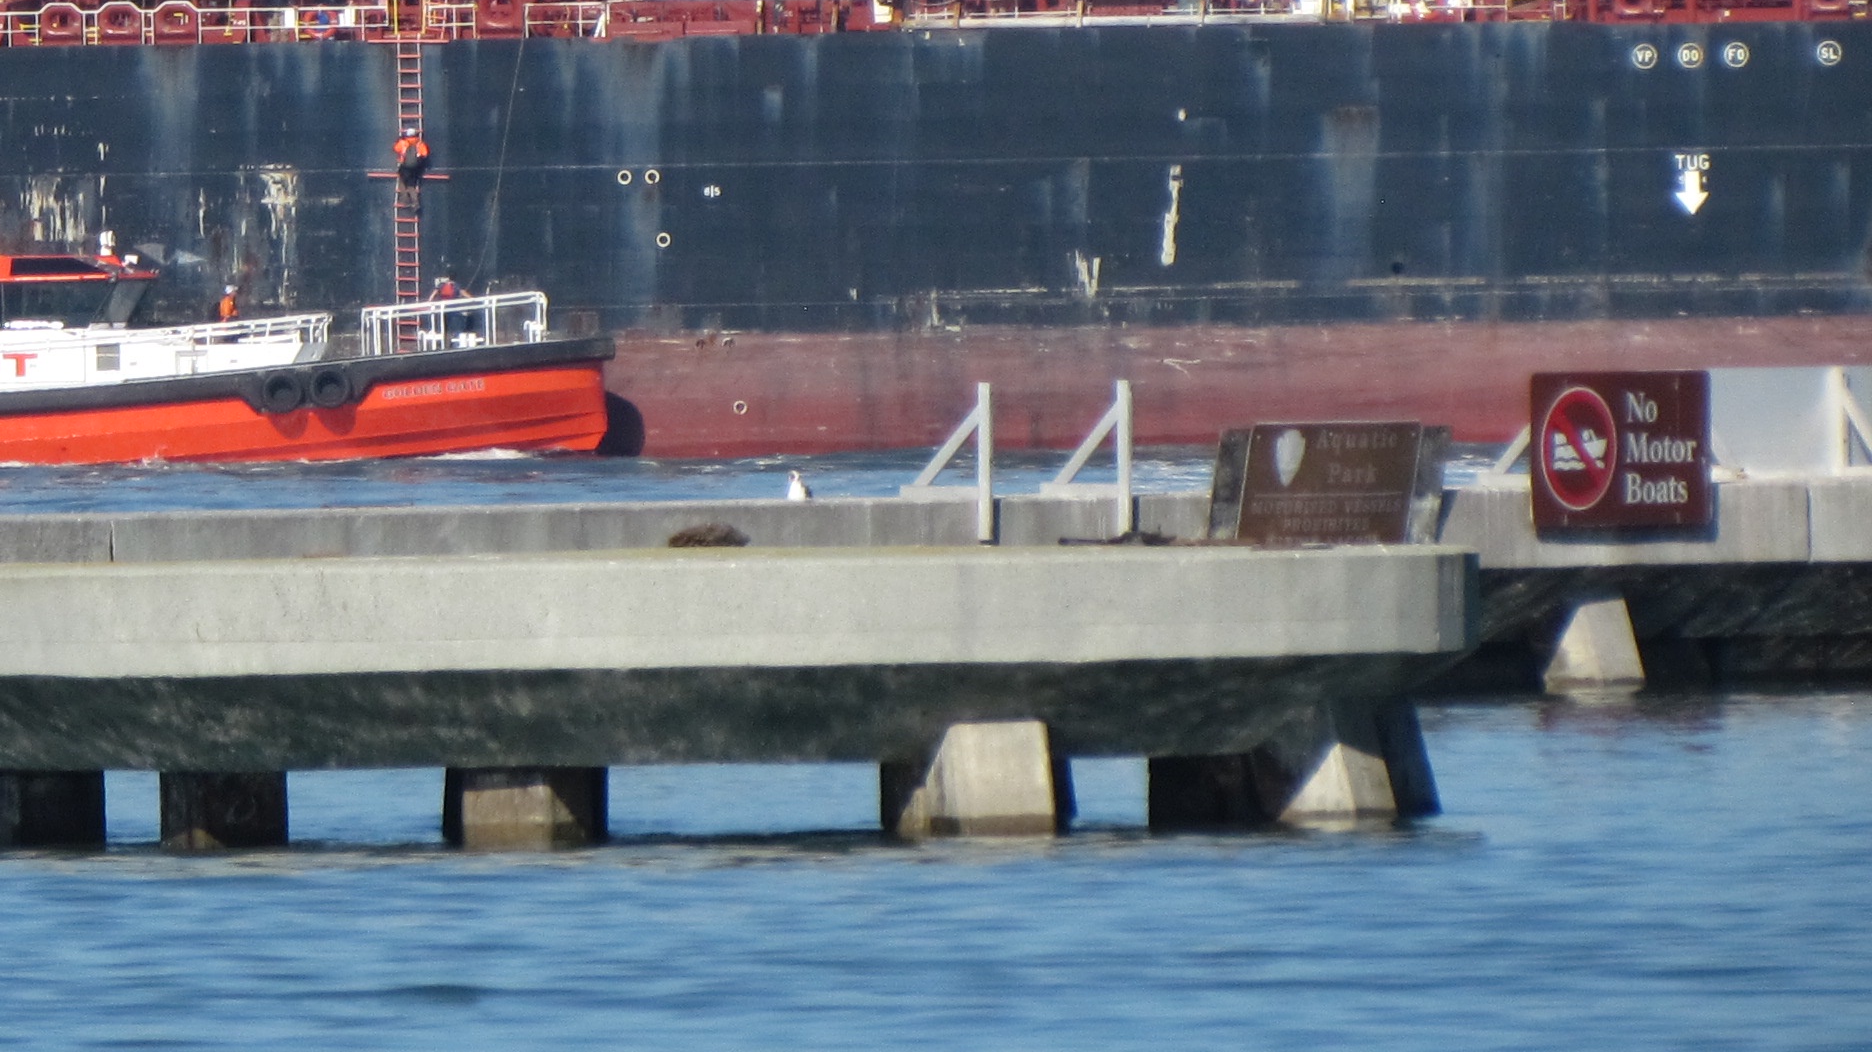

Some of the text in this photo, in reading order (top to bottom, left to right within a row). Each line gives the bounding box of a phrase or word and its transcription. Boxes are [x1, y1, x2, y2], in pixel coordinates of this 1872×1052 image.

[1636, 50, 1653, 62] VP
[1821, 48, 1837, 60] SL
[1675, 154, 1710, 170] TUG
[1626, 391, 1659, 423] No
[1316, 430, 1398, 456] Aquatic
[1626, 432, 1697, 463] Motor
[1327, 462, 1378, 484] Park
[1625, 472, 1688, 504] Boats
